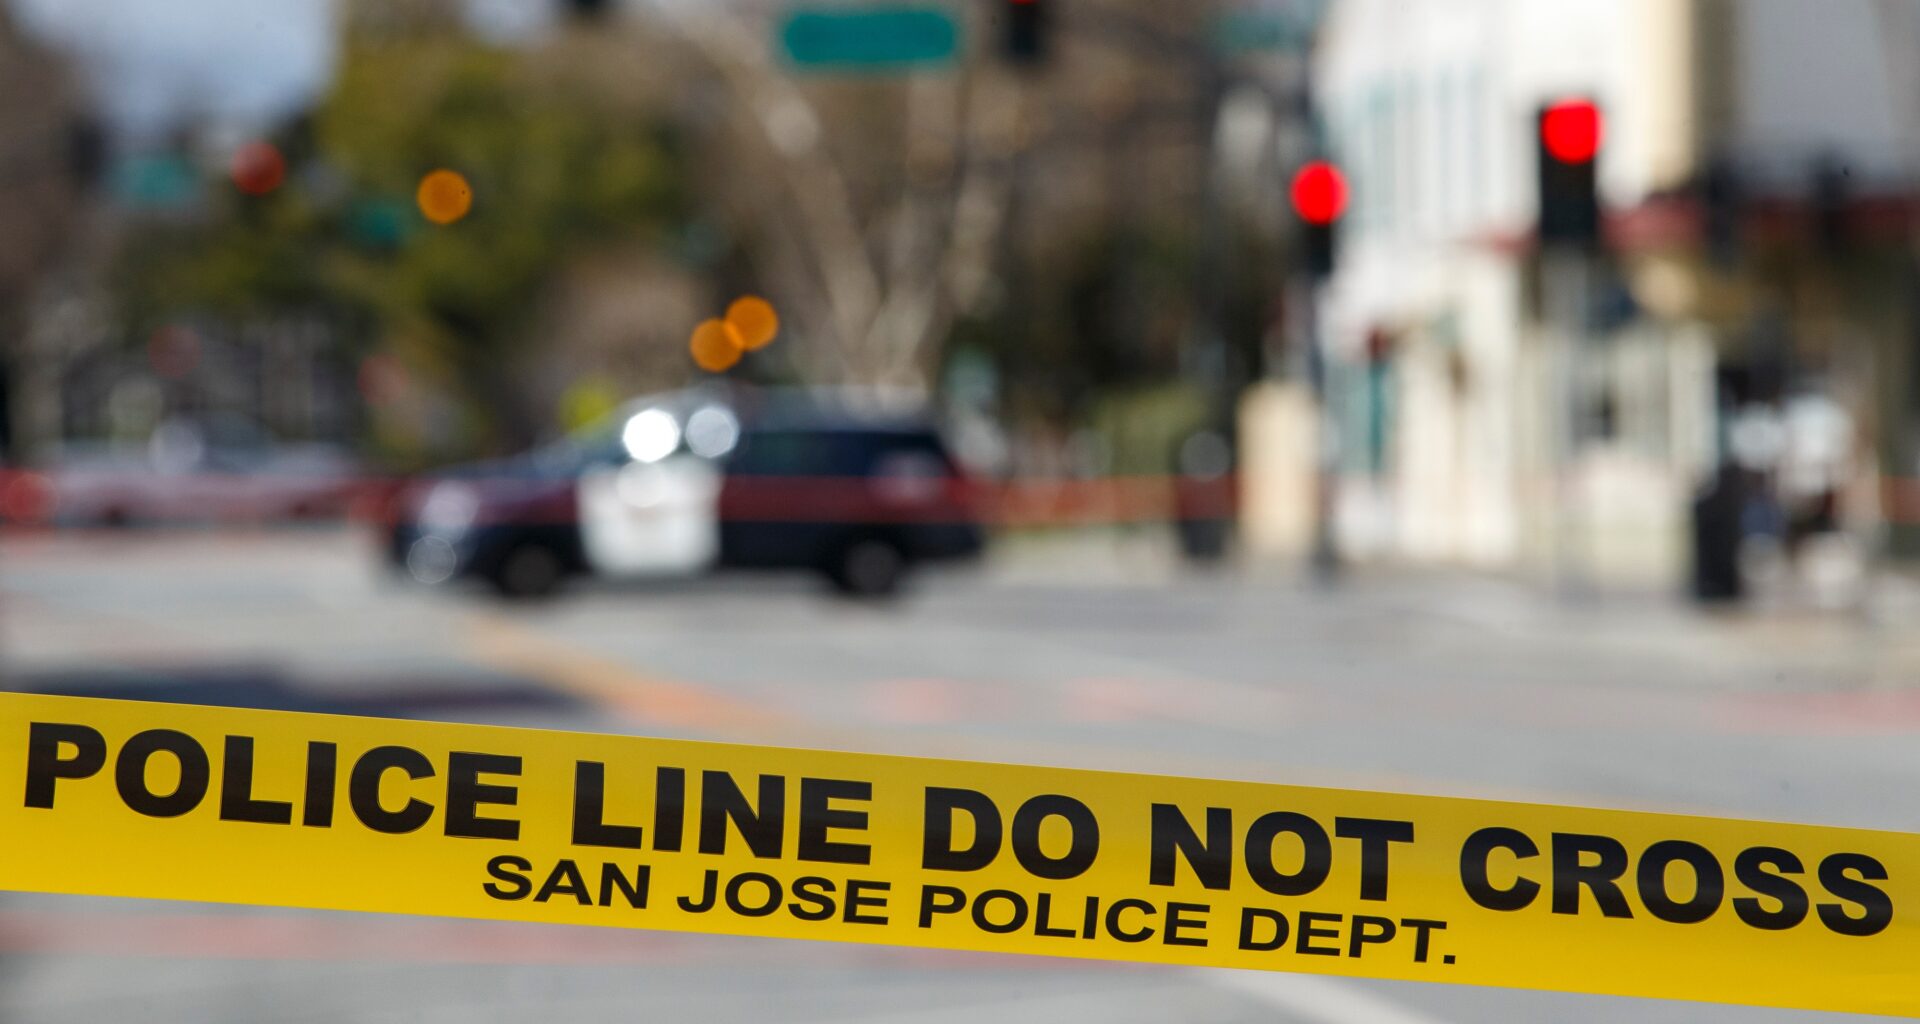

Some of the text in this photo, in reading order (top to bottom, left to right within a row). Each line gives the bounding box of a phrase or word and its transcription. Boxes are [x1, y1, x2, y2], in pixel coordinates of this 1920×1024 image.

[24, 721, 1894, 937] POLICE LINE DO NOT CROSS
[482, 855, 1456, 965] SAN JOSE POLICE DEPT.
